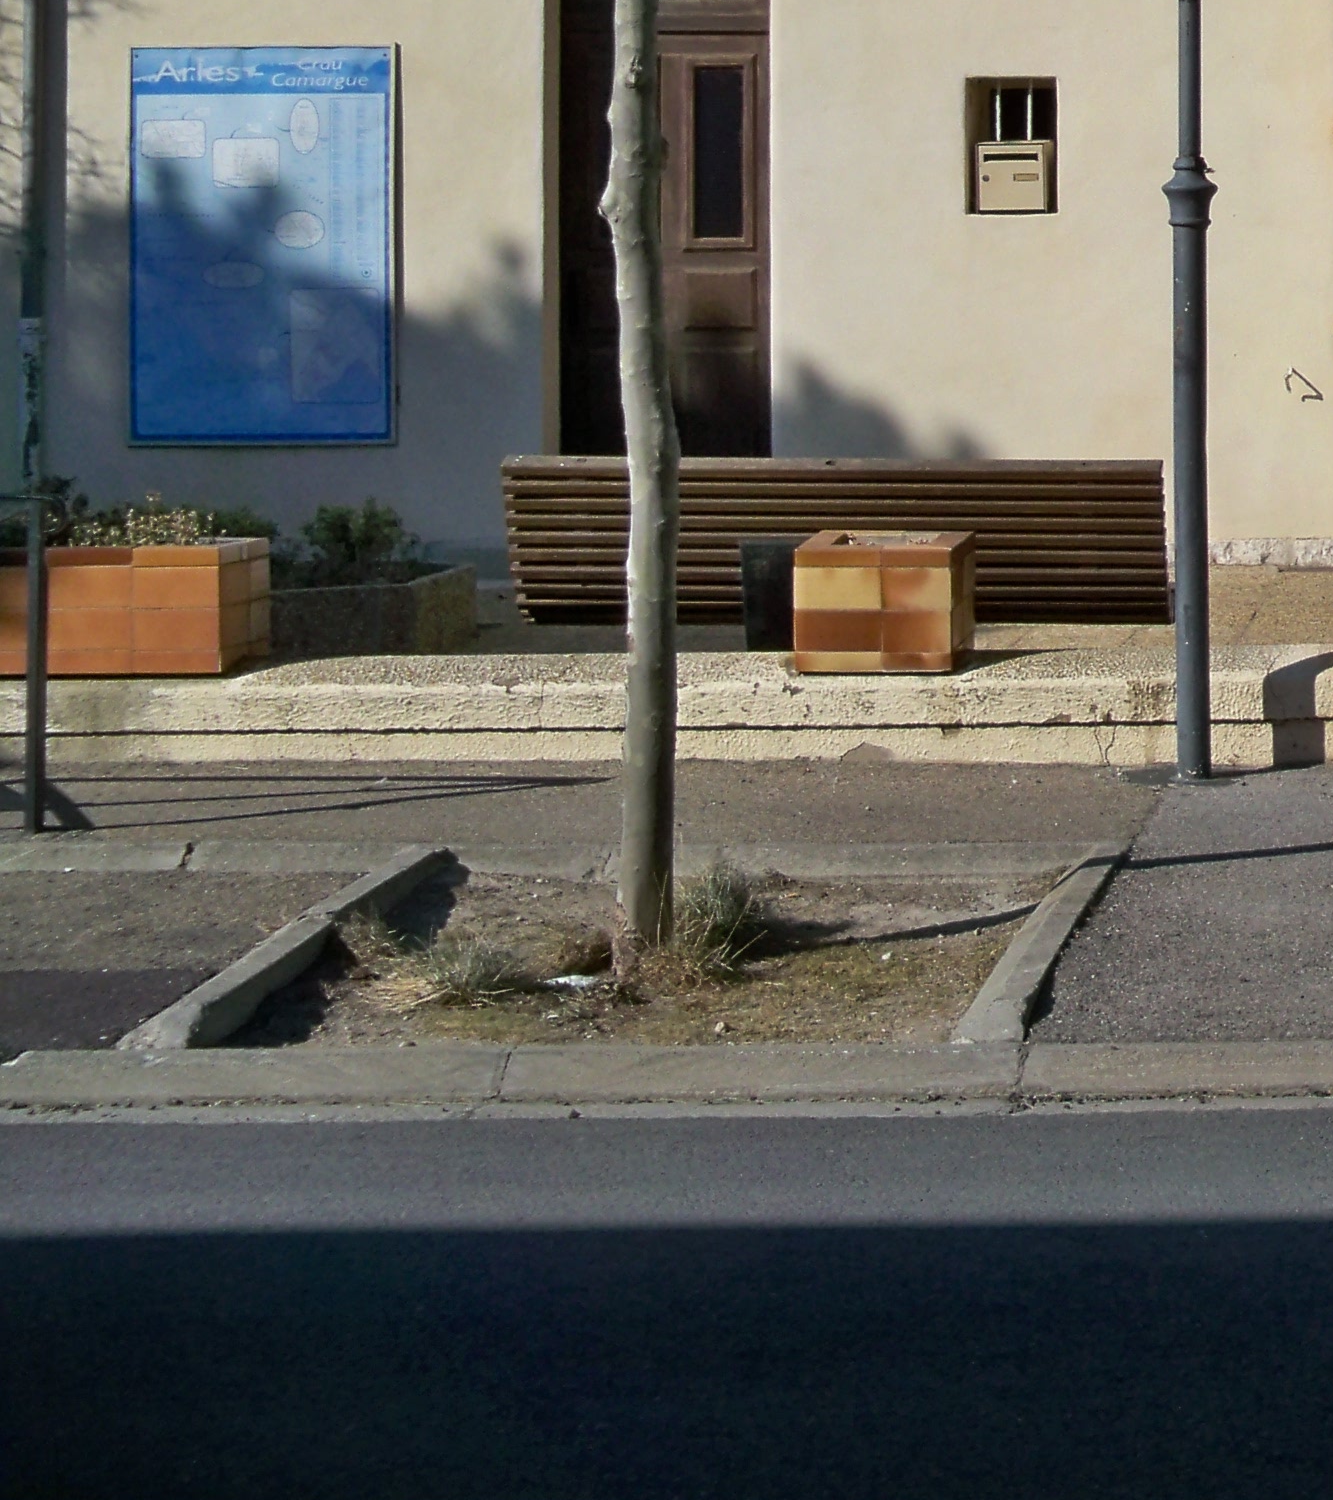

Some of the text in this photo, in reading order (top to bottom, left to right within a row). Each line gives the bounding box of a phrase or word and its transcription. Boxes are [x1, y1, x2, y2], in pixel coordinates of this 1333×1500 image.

[156, 60, 240, 82] Arles
[299, 57, 342, 71] Crau
[271, 73, 369, 89] Camargue
